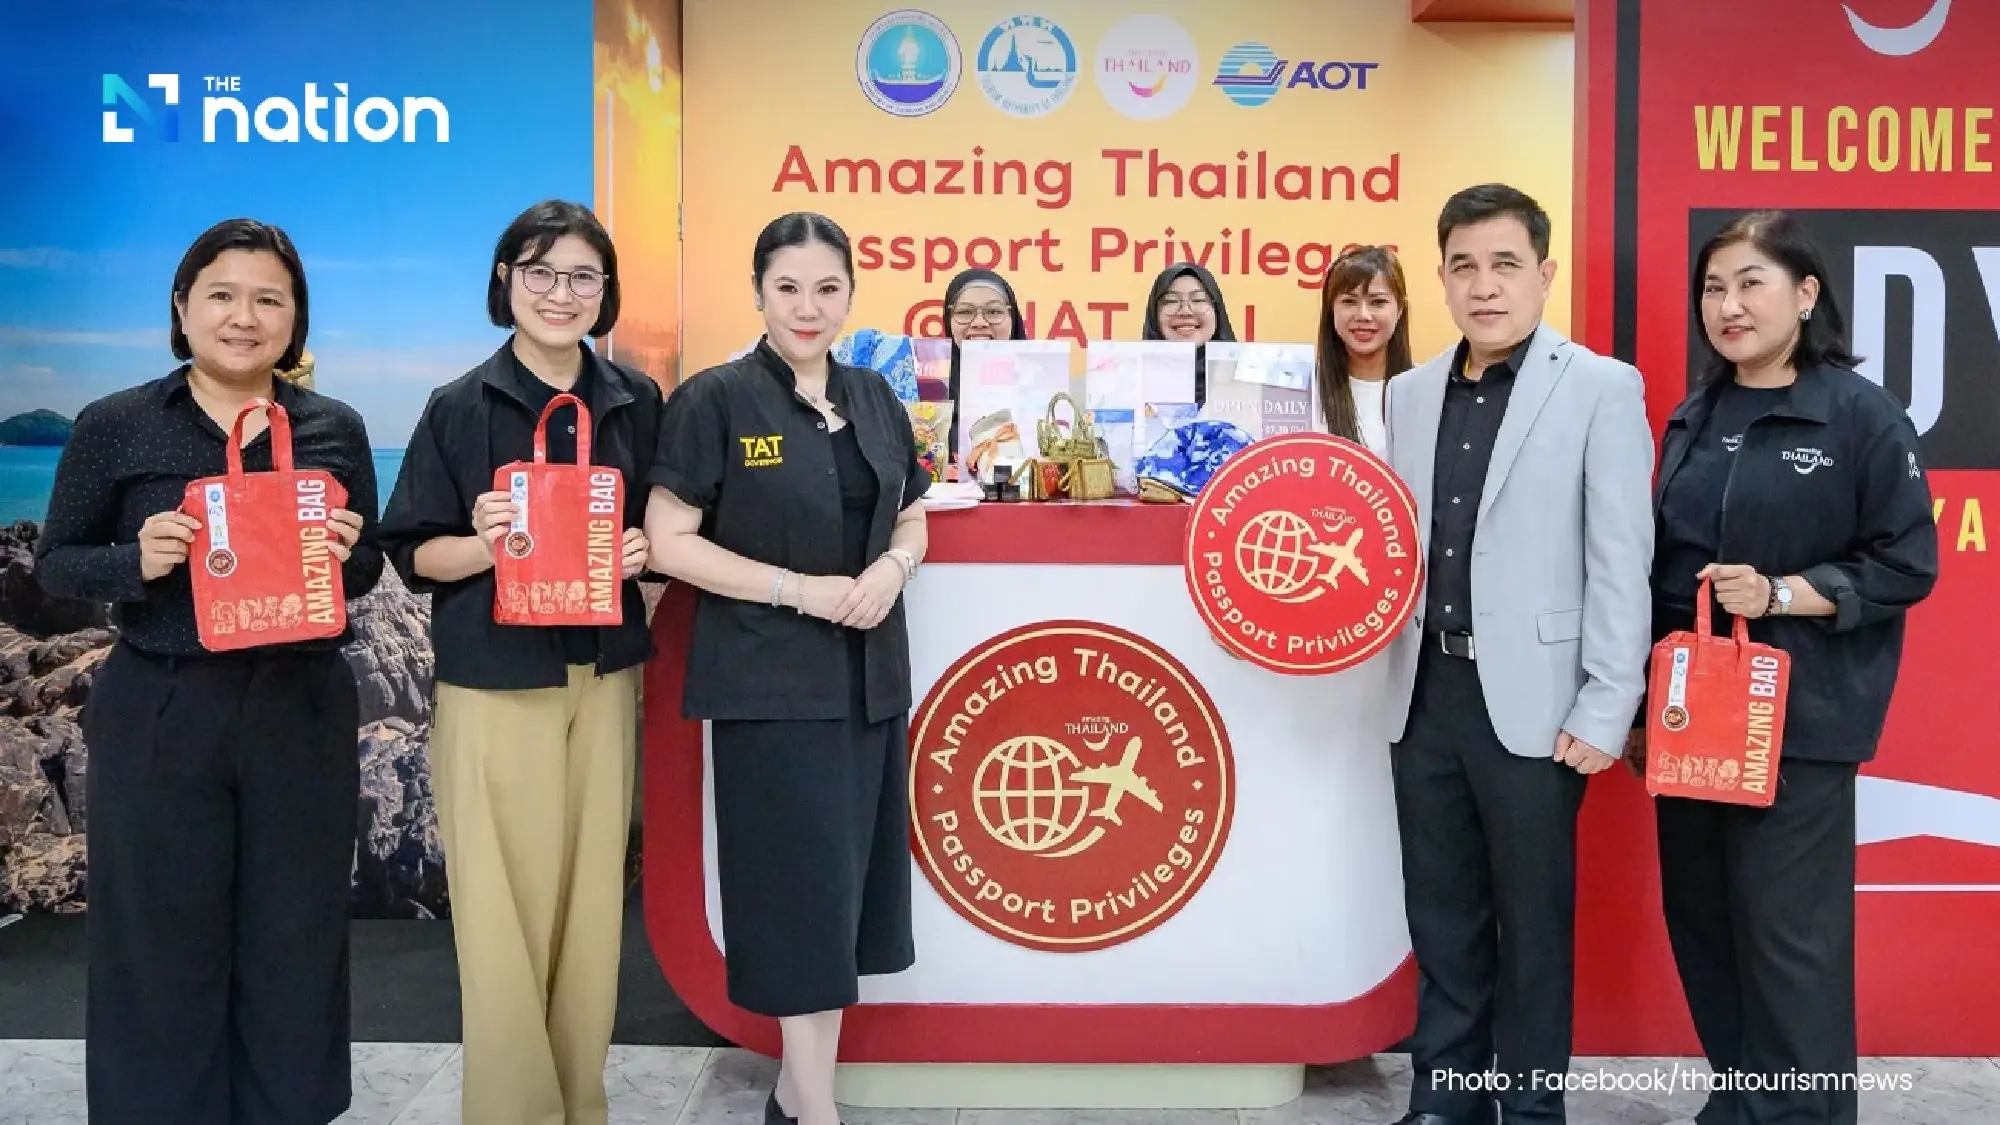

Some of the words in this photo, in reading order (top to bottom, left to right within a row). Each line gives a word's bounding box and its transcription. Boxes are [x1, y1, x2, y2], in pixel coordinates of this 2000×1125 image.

[1286, 61, 1379, 89] AOT
[1694, 105, 1993, 172] WELCOME
[772, 145, 1072, 209] Amazing
[1101, 148, 1400, 202] Thailand
[857, 228, 1064, 283] ssport
[1264, 400, 1309, 415] DAILY
[740, 435, 783, 457] TAT
[1782, 451, 1834, 467] THAILAND
[296, 479, 327, 522] BAG
[588, 473, 616, 513] BAG
[1210, 456, 1316, 526] Amazing
[1328, 456, 1407, 558] Thailand
[300, 526, 336, 624] AMAZING
[587, 519, 615, 614] AMAZING
[1203, 551, 1278, 649] Passport
[1287, 587, 1399, 655] Privileges
[1749, 655, 1779, 698] BAG
[931, 655, 1058, 774] Amazing
[1074, 648, 1206, 769] Thailand
[1064, 722, 1129, 734] THAILAND
[1742, 701, 1775, 795] AMAZING
[932, 811, 1056, 924] Passport
[1070, 809, 1205, 924] Privileges
